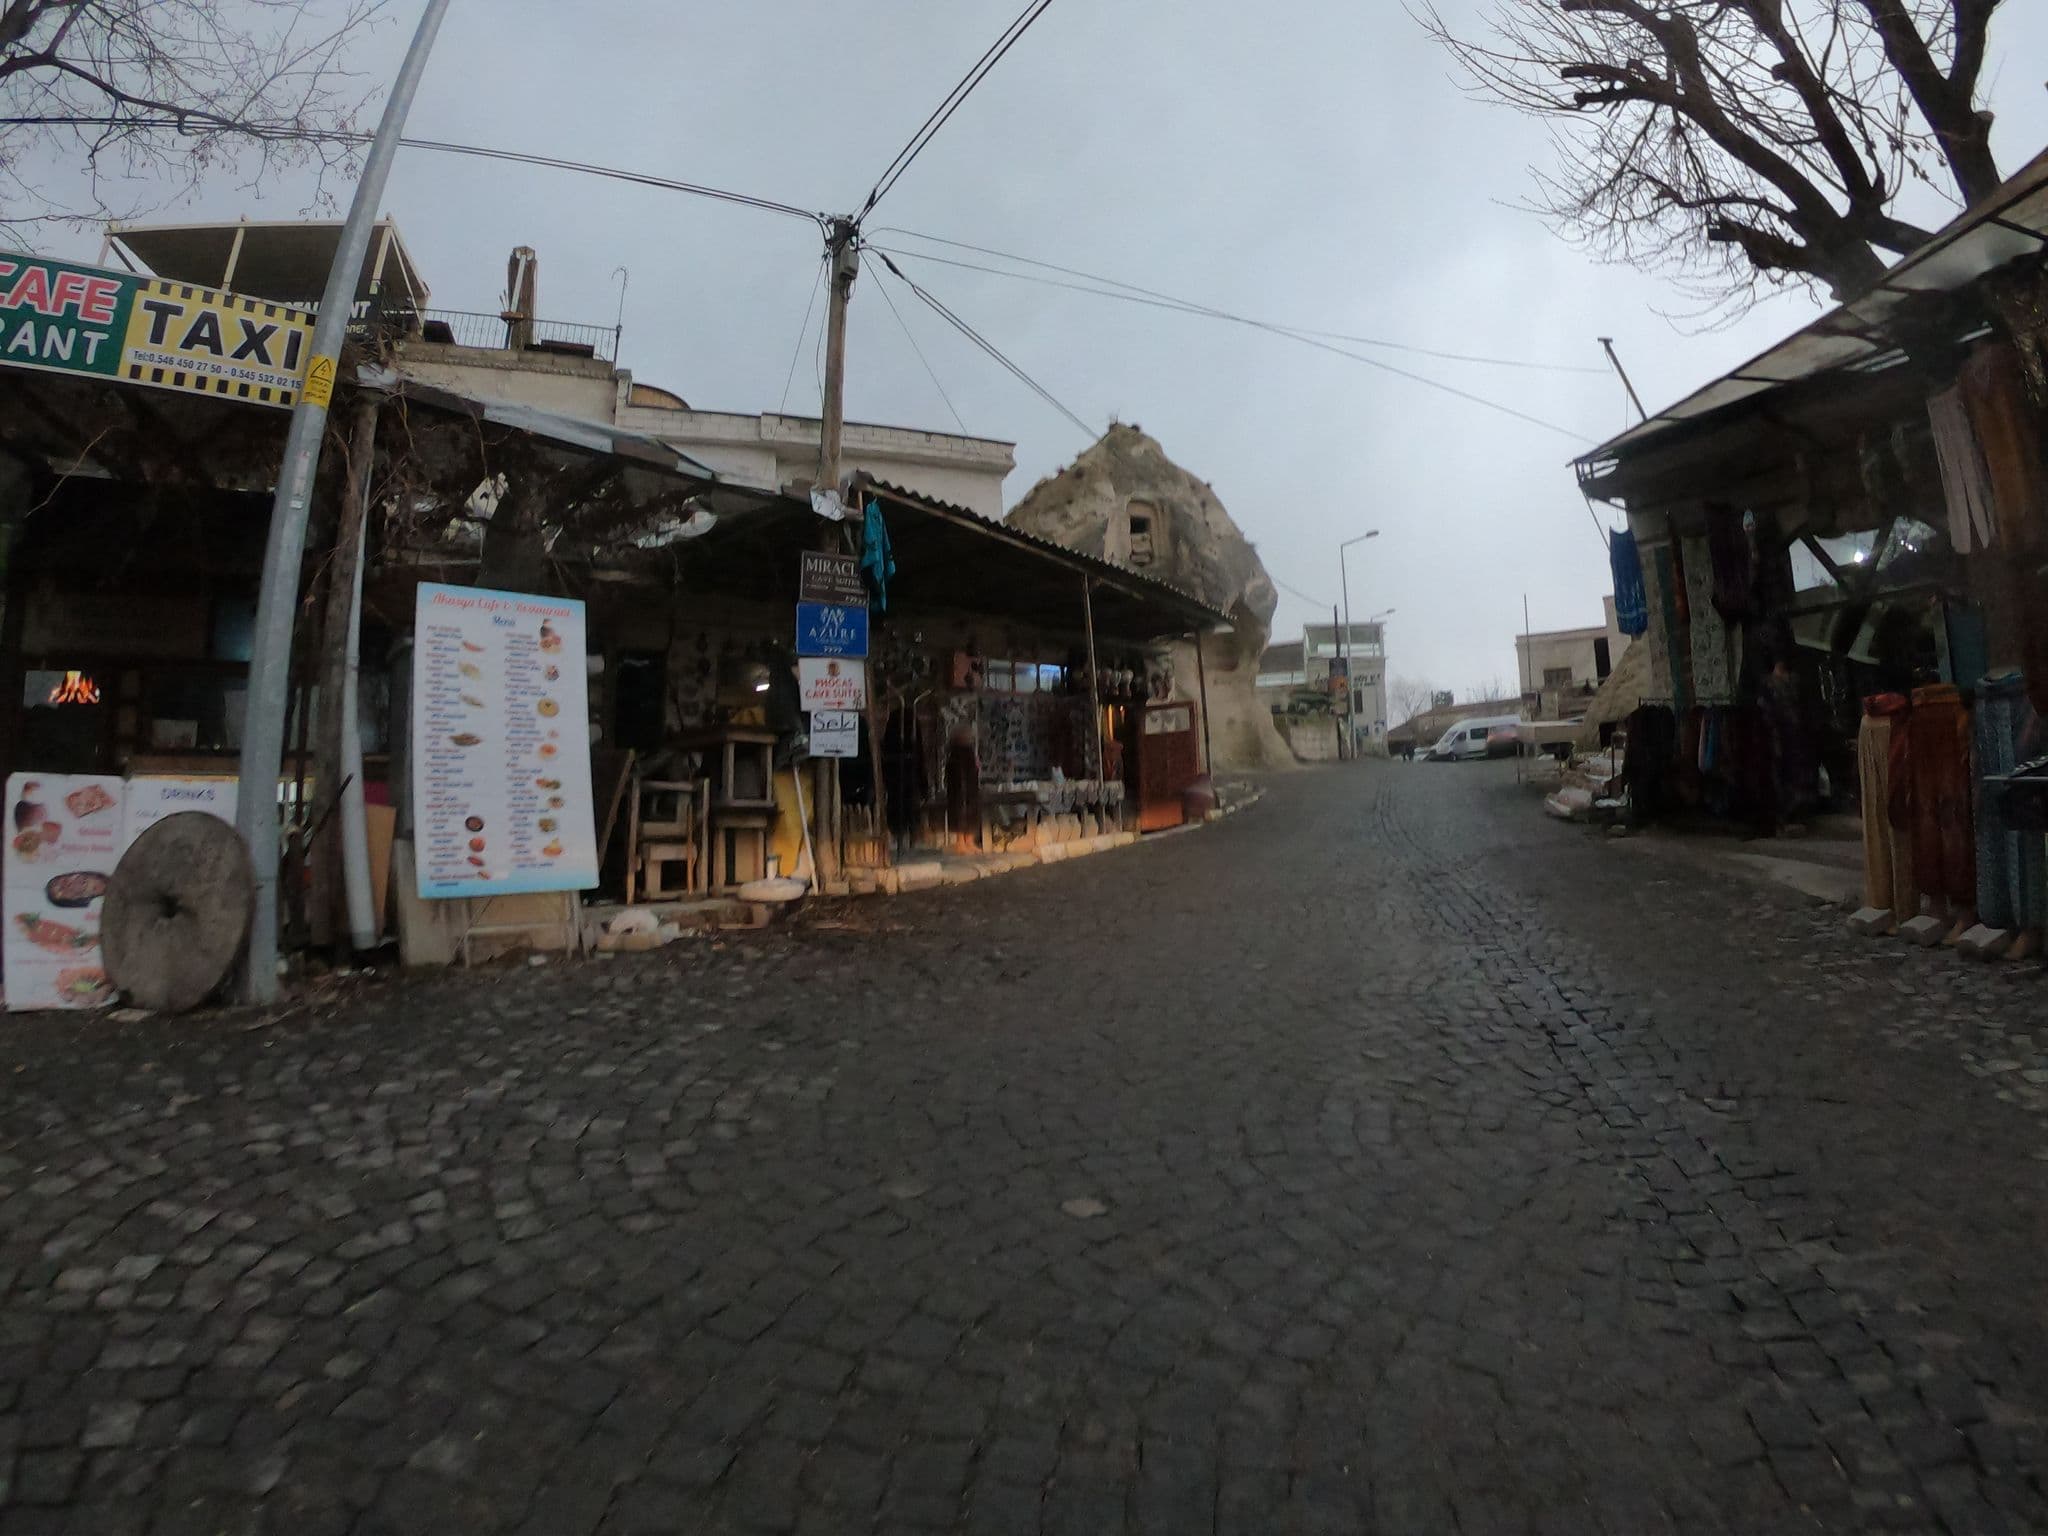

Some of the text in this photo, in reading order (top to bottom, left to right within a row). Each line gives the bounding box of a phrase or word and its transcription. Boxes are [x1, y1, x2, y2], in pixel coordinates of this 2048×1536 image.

[0, 318, 109, 365] ANT
[144, 300, 302, 371] TAXI
[177, 359, 194, 370] 450
[197, 362, 208, 371] 27
[211, 365, 222, 374] 50
[231, 368, 255, 380] 0.545
[259, 373, 274, 384] 532
[277, 377, 288, 387] 02
[808, 627, 856, 640] AZURE
